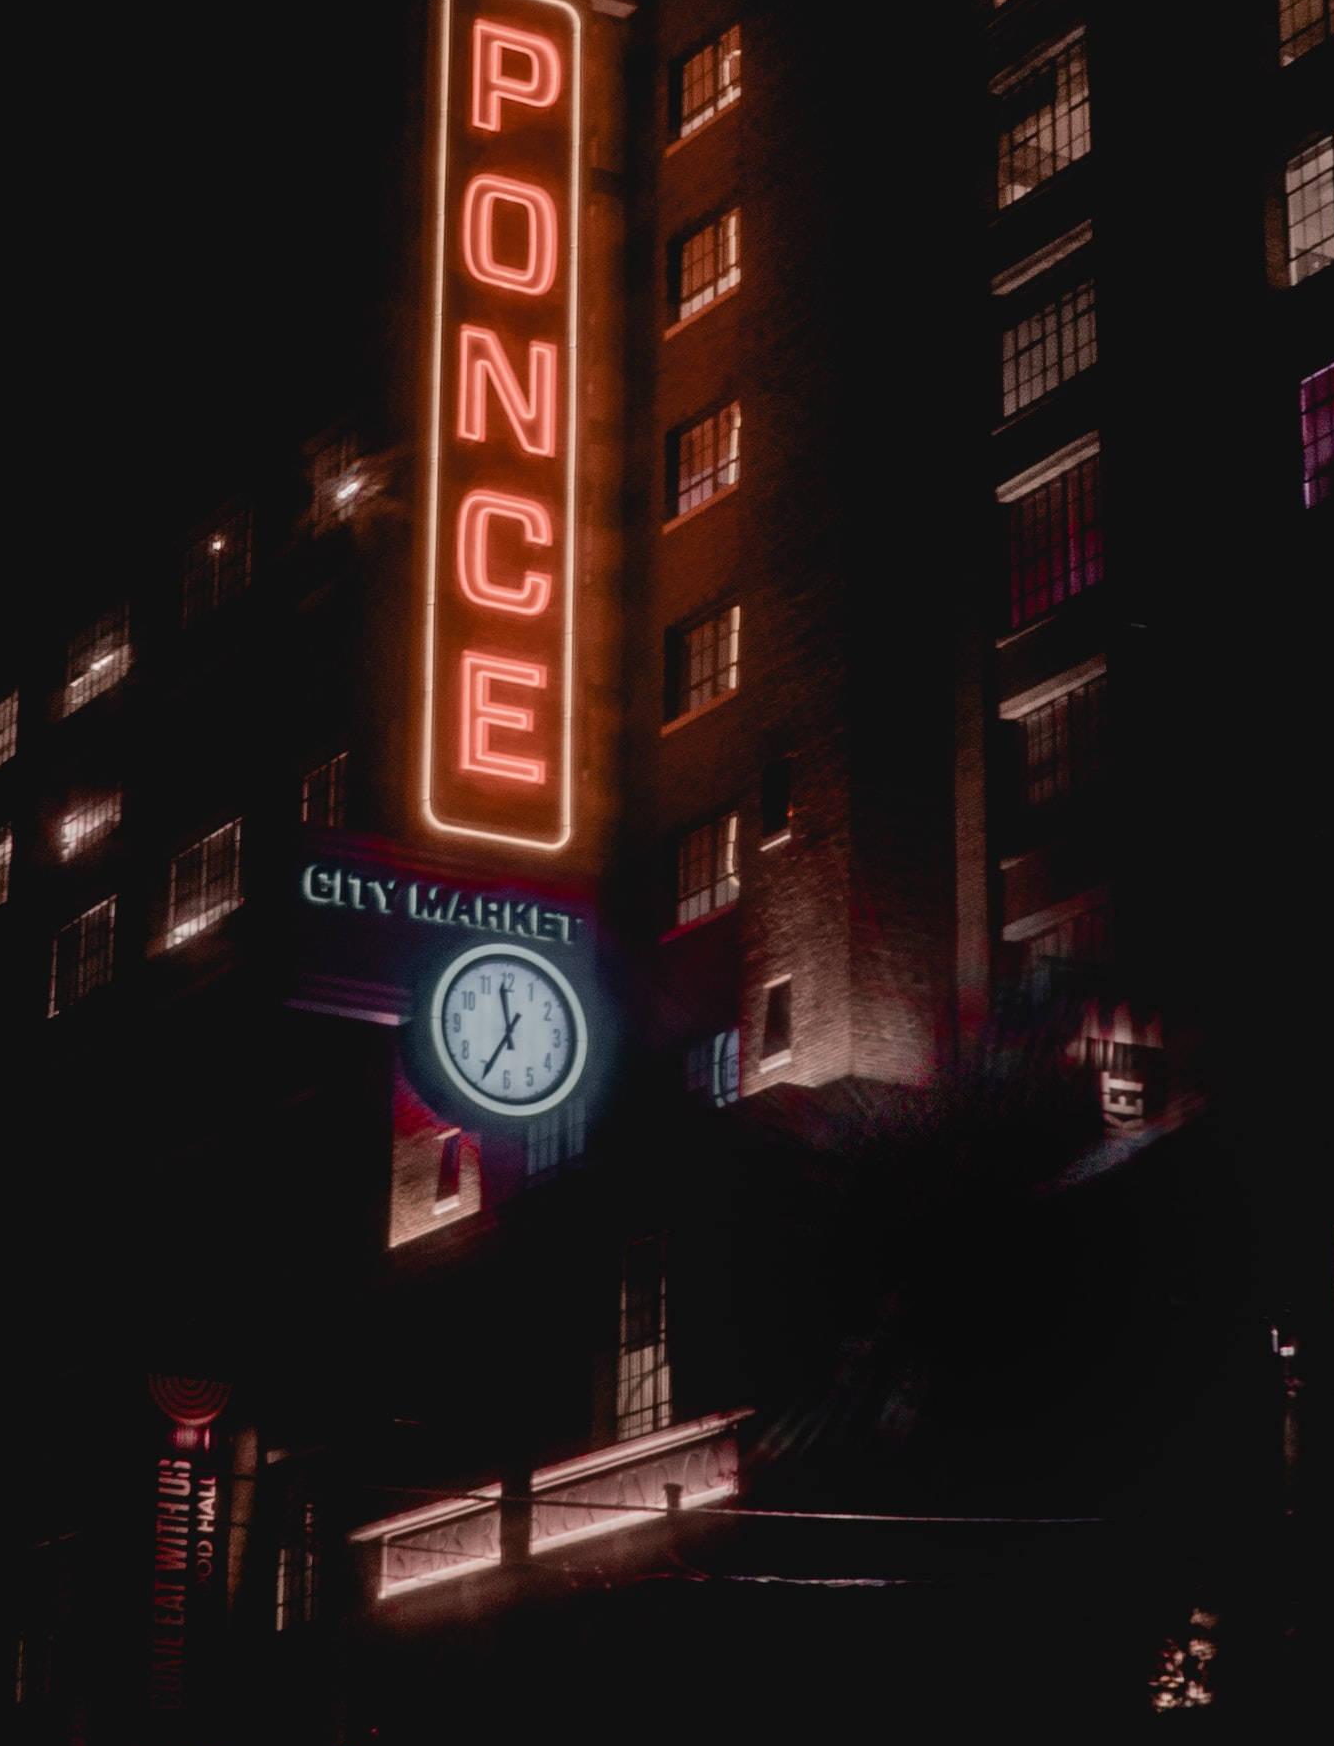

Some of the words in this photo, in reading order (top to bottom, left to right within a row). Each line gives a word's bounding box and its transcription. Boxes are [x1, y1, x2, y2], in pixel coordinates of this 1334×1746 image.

[457, 18, 561, 785] PONCE
[300, 862, 397, 916] CITY
[406, 880, 583, 944] MARKET
[480, 974, 492, 995] 11
[501, 972, 516, 993] 12
[527, 982, 534, 1003] 1
[461, 991, 476, 1011] 10
[543, 1001, 553, 1022] 2
[453, 1012, 462, 1033] 9
[553, 1028, 562, 1049] 3
[461, 1039, 470, 1060] 8
[543, 1052, 553, 1073] 4
[502, 1069, 512, 1090] 6
[525, 1066, 535, 1088] 5
[157, 1458, 193, 1497] US
[195, 1475, 217, 1533] HALL
[155, 1500, 191, 1572] WITH
[153, 1580, 187, 1628] EAT
